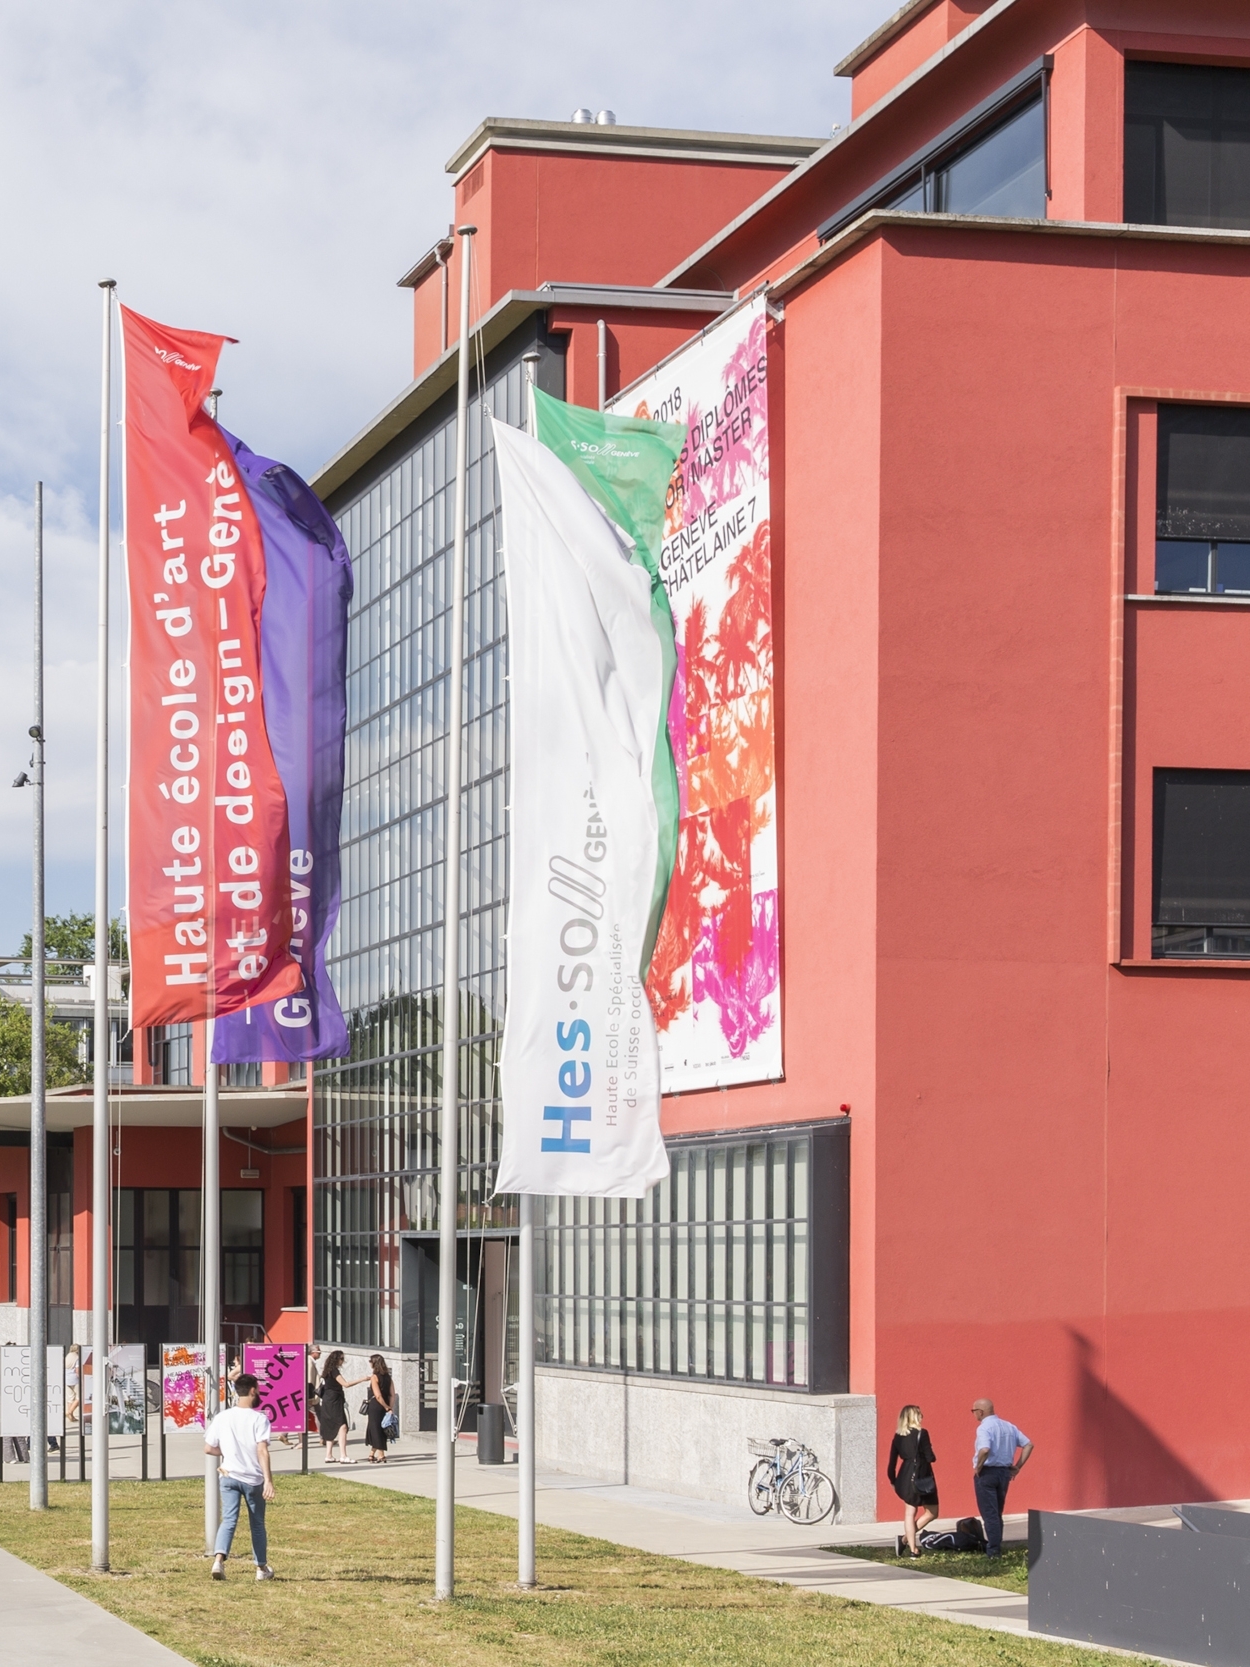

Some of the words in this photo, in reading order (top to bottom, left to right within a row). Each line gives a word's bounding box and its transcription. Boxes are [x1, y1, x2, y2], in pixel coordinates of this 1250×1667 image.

[691, 355, 768, 453] DIPLÔMES
[664, 406, 752, 510] OR/MASTER
[200, 452, 243, 590] Genè
[660, 500, 718, 571] GENÈVE
[748, 495, 757, 524] 7
[158, 658, 201, 804] école
[215, 638, 256, 825] design
[162, 826, 209, 986] Haute
[219, 846, 263, 910] de
[225, 927, 269, 981] et
[627, 975, 642, 1020] occid
[605, 1022, 620, 1068] Ecole
[624, 1026, 641, 1081] Suisse
[605, 1075, 618, 1127] Haute
[623, 1089, 637, 1109] de
[260, 1389, 304, 1424] OFF
